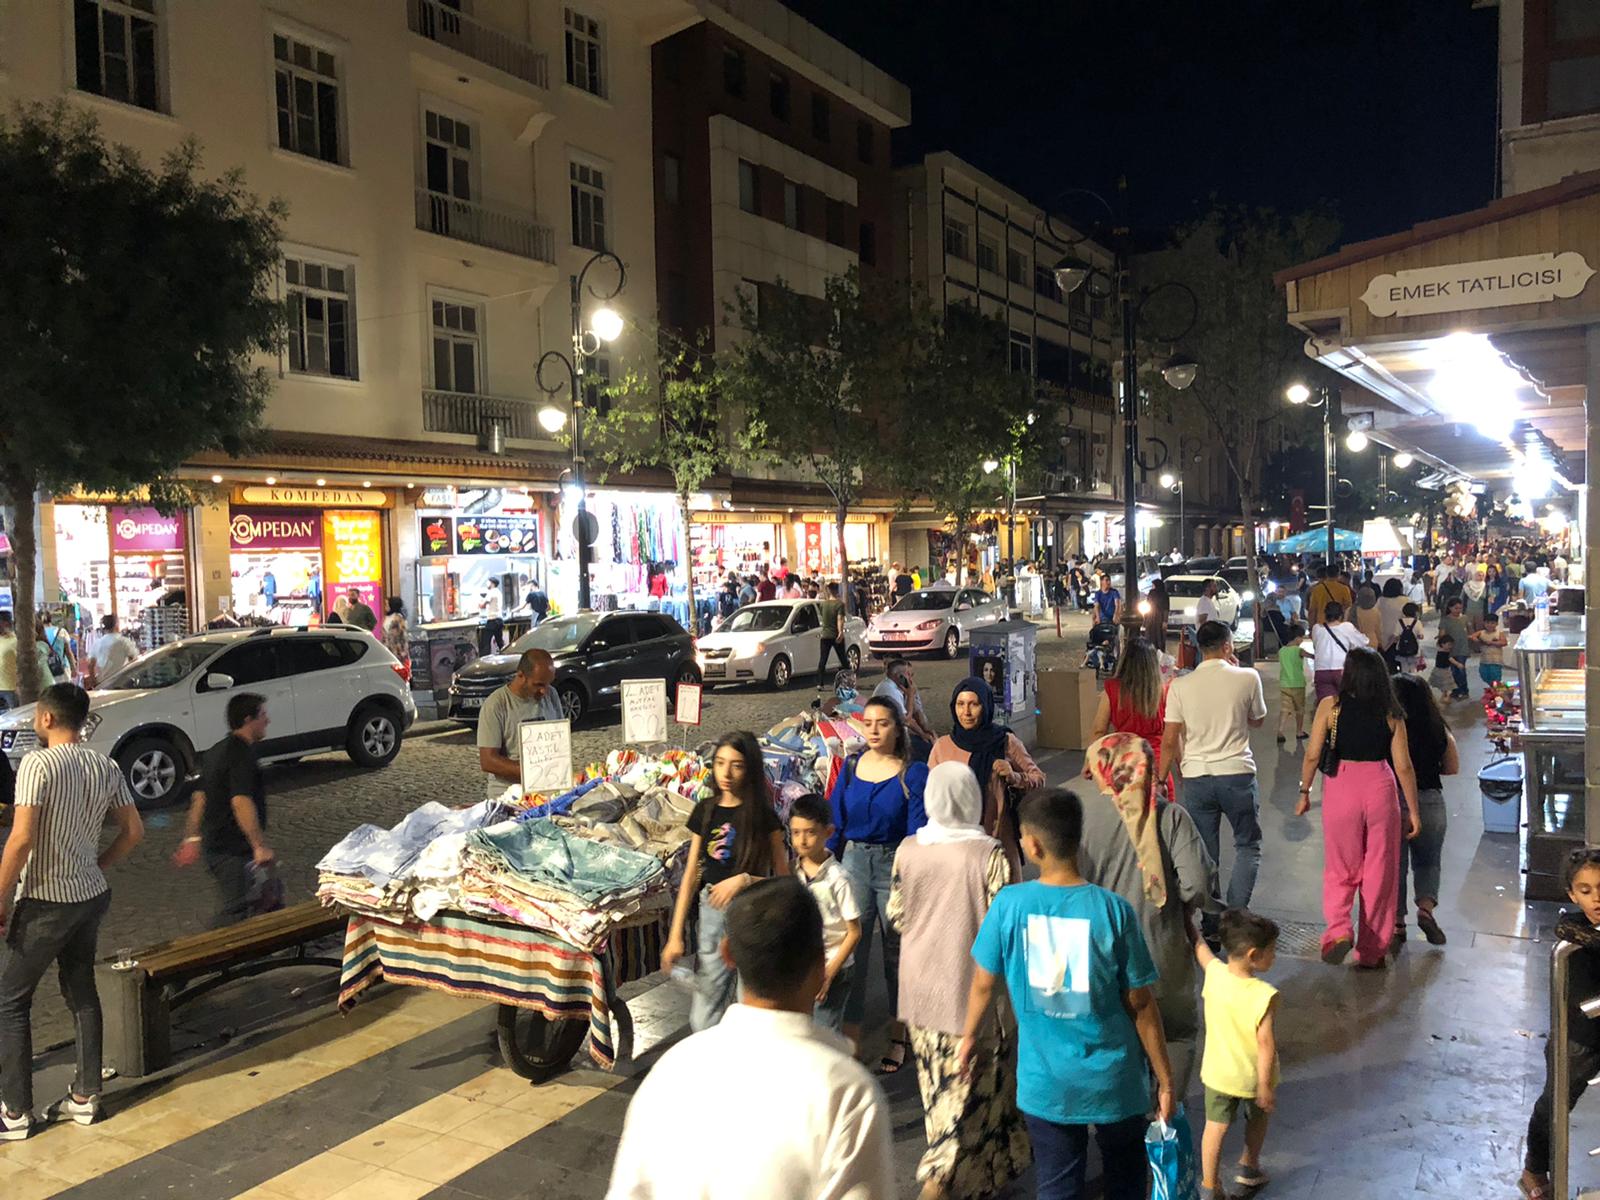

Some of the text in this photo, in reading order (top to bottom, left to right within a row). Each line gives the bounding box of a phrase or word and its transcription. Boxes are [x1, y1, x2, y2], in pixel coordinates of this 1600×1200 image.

[1389, 268, 1562, 301] EMEK TATLICISI
[270, 490, 364, 503] KOMPEDAN
[536, 731, 564, 742] ADET
